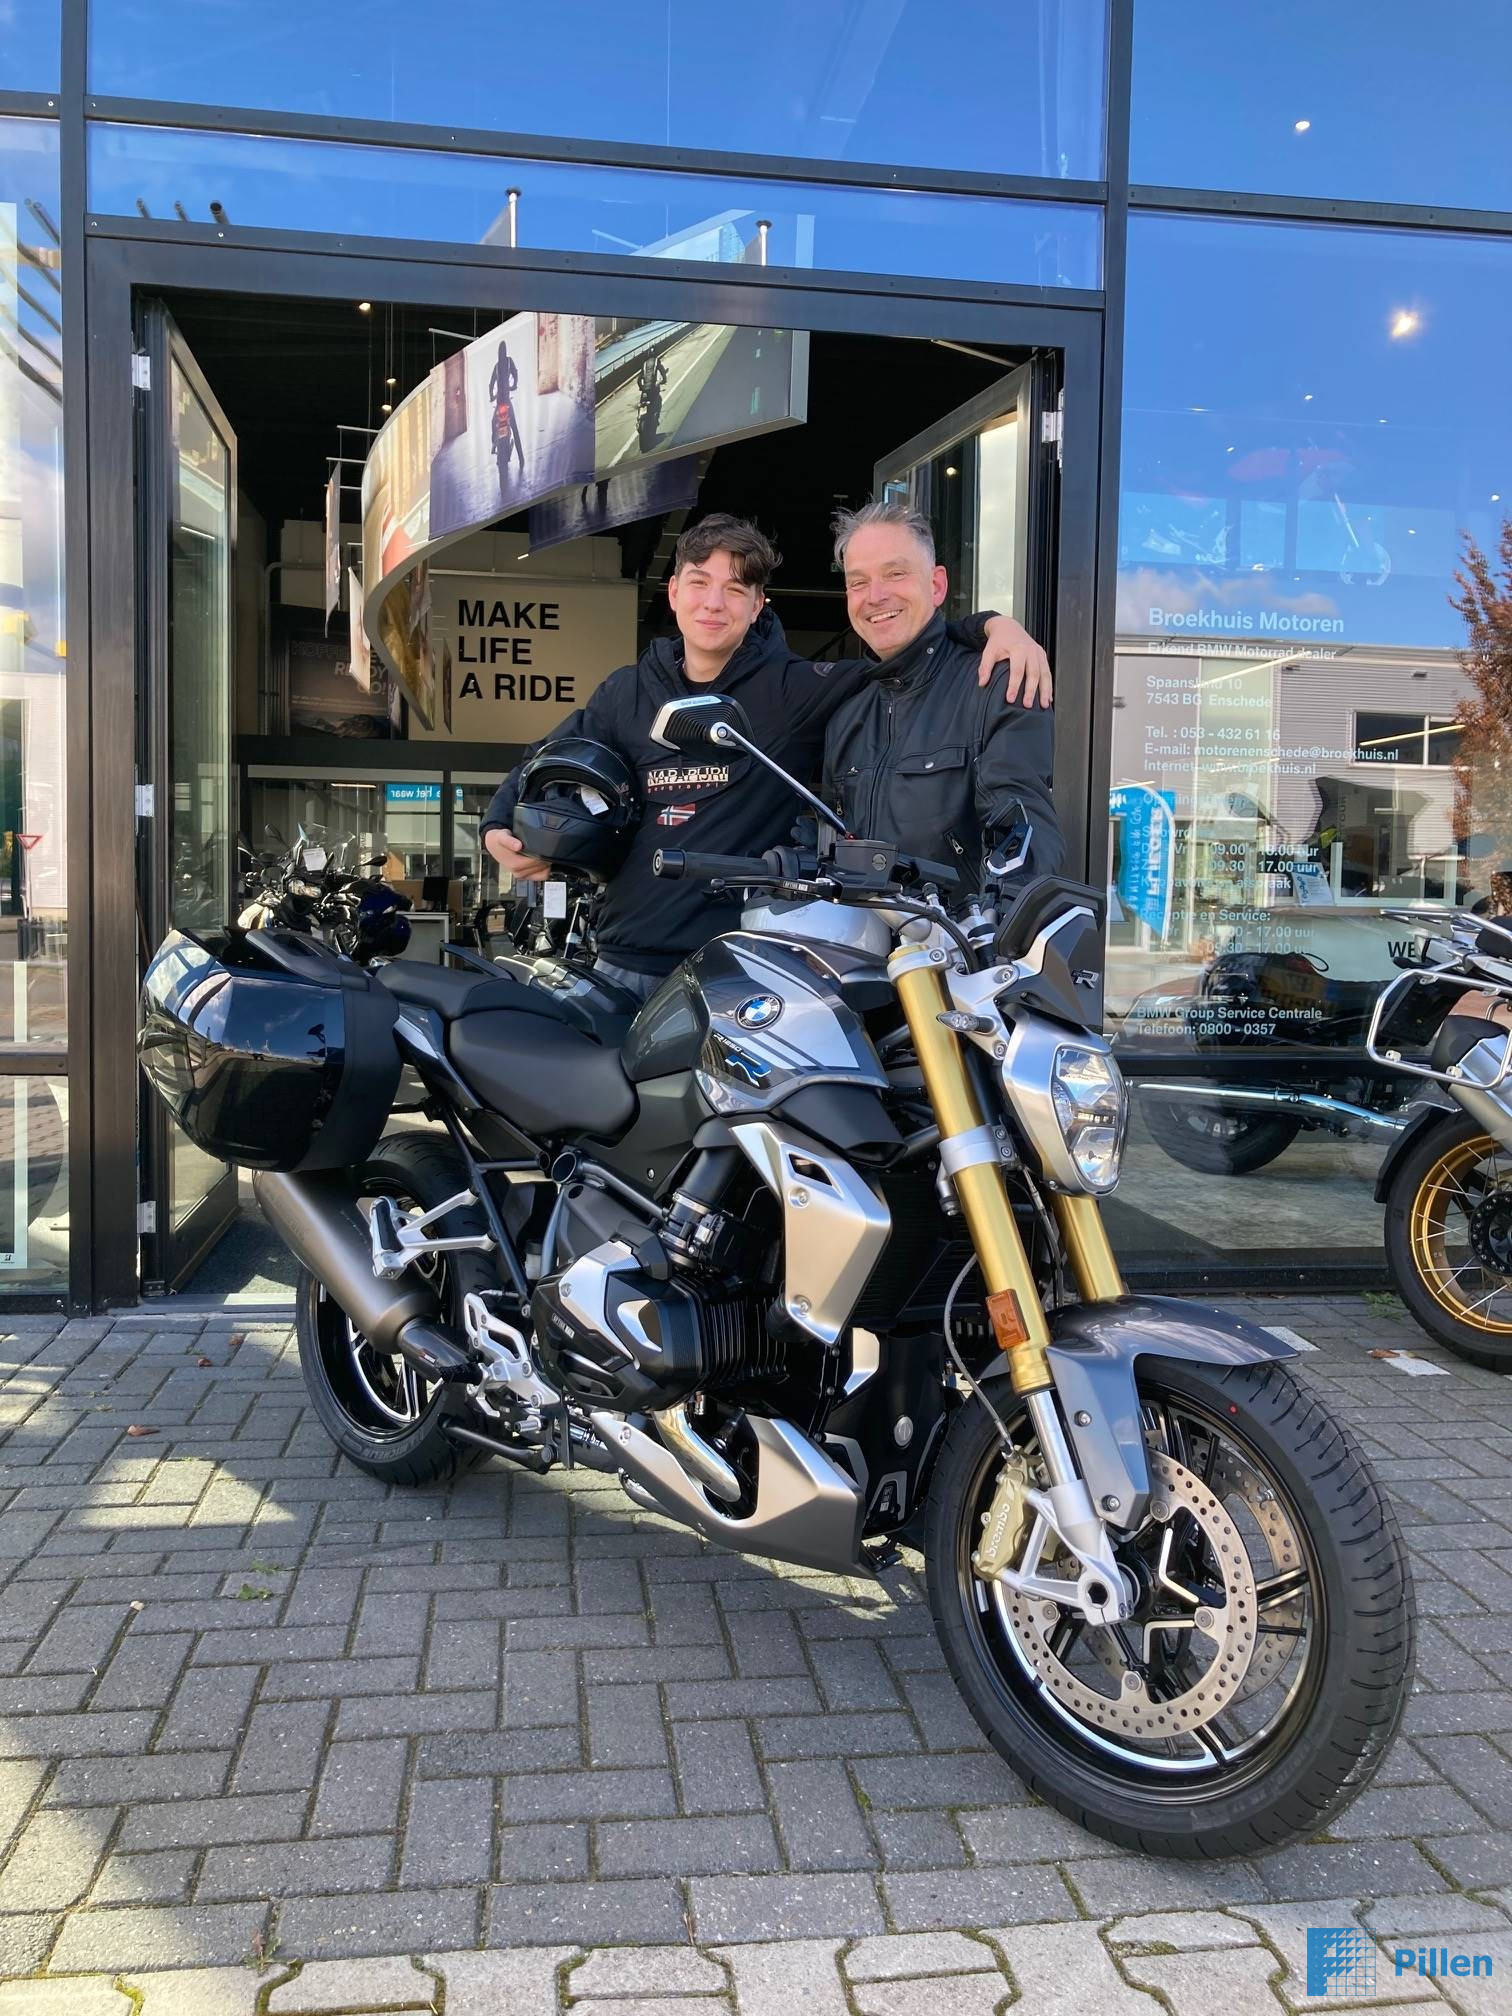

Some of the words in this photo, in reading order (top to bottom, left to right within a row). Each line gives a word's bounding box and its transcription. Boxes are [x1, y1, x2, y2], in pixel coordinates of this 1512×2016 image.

[458, 599, 560, 630] MAKE
[1148, 608, 1253, 629] Broekhuis
[1259, 612, 1344, 633] Motoren
[458, 636, 532, 665] LIFE
[1197, 644, 1232, 656] BMW
[1235, 645, 1294, 659] Motorrad
[459, 672, 483, 699] A
[494, 674, 576, 703] RIDE
[1227, 678, 1242, 690] 10
[1146, 692, 1179, 705] 7543
[1208, 694, 1273, 708] Enschede
[1145, 726, 1168, 738] Tel.
[1180, 726, 1205, 739] 053
[1217, 728, 1242, 740] 432
[1245, 728, 1260, 740] 61
[1144, 743, 1191, 756] E-mail:
[1259, 860, 1294, 872] 17.00
[1296, 862, 1318, 873] uur
[1219, 909, 1271, 922] Service:
[1256, 926, 1292, 938] 17.00
[1256, 942, 1292, 954] 17.00
[1137, 1007, 1173, 1019] BMW
[1175, 1007, 1215, 1023] Group
[1217, 1007, 1265, 1019] Service
[1268, 1007, 1322, 1020] Centrale
[1136, 1022, 1196, 1035] Telefoon:
[1199, 1023, 1232, 1035] 0800
[1244, 1023, 1276, 1035] 0357
[985, 1503, 1011, 1558] brembo
